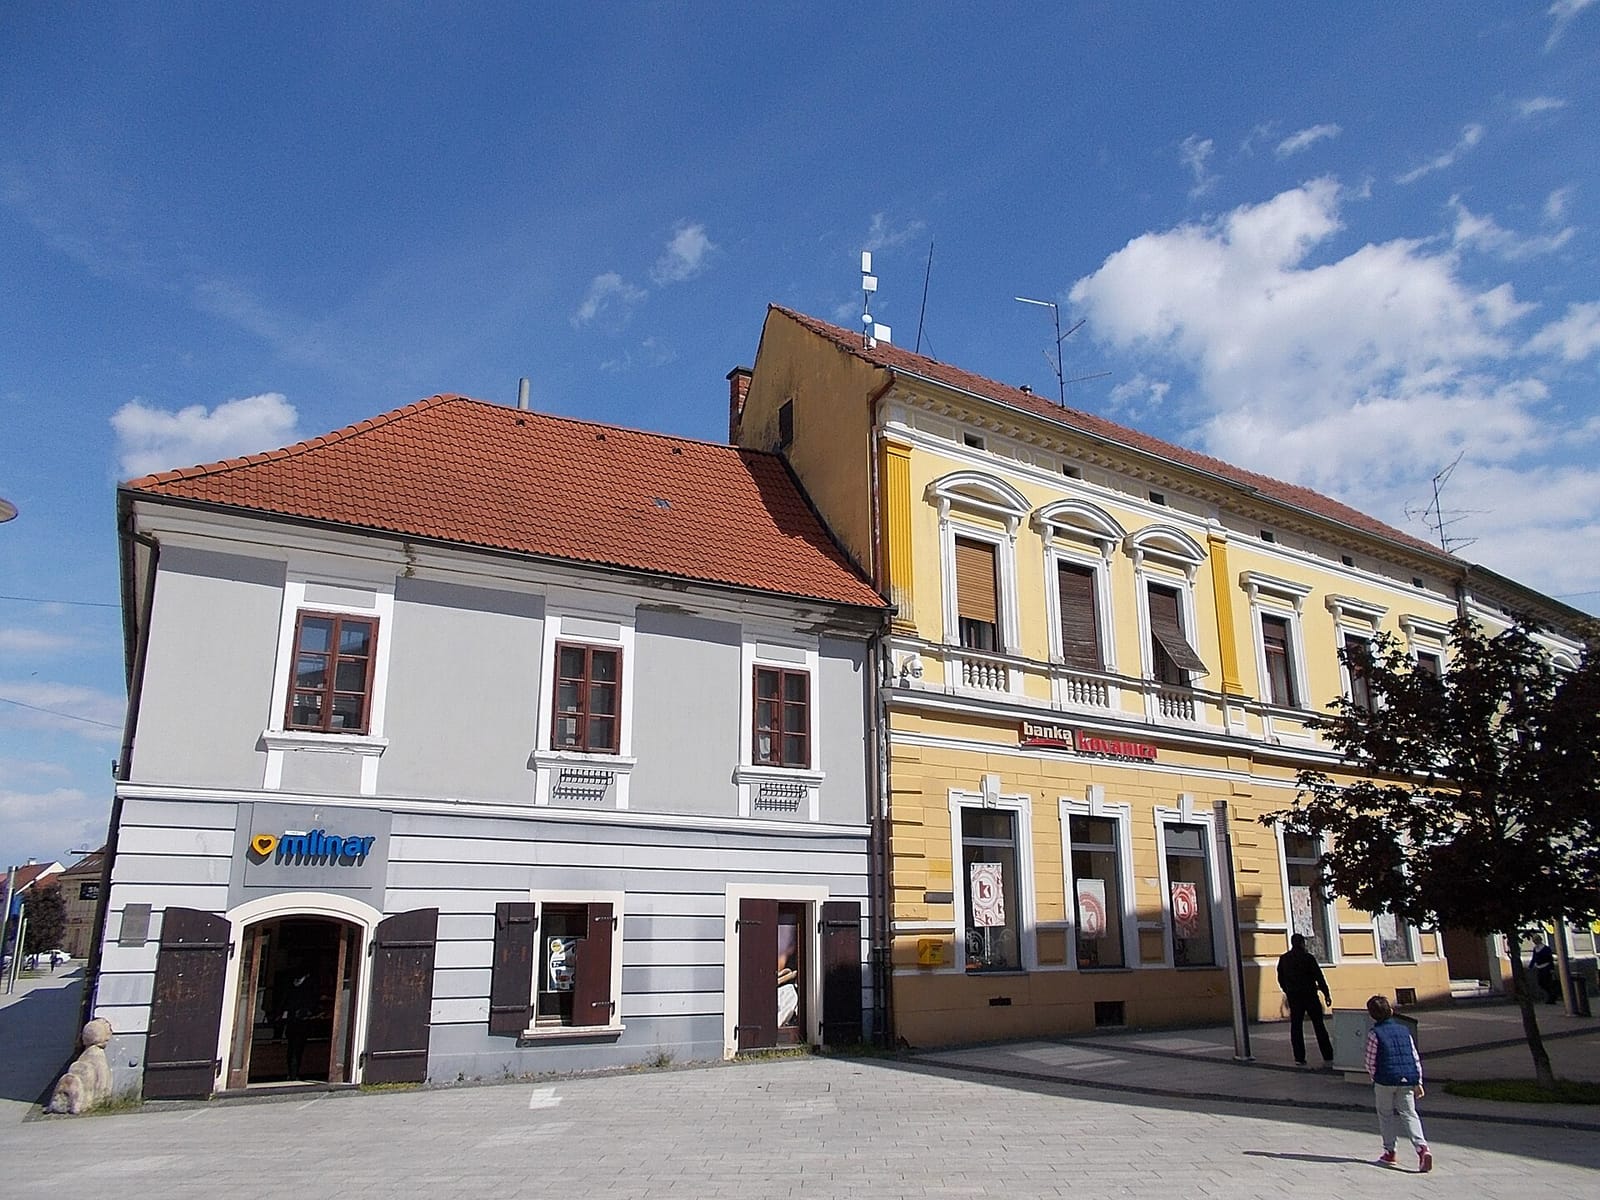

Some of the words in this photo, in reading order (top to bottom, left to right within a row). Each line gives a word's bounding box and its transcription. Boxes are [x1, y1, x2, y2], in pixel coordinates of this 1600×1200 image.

[1023, 721, 1073, 742] banka
[1076, 728, 1158, 759] kovanica
[279, 829, 376, 857] mlinar
